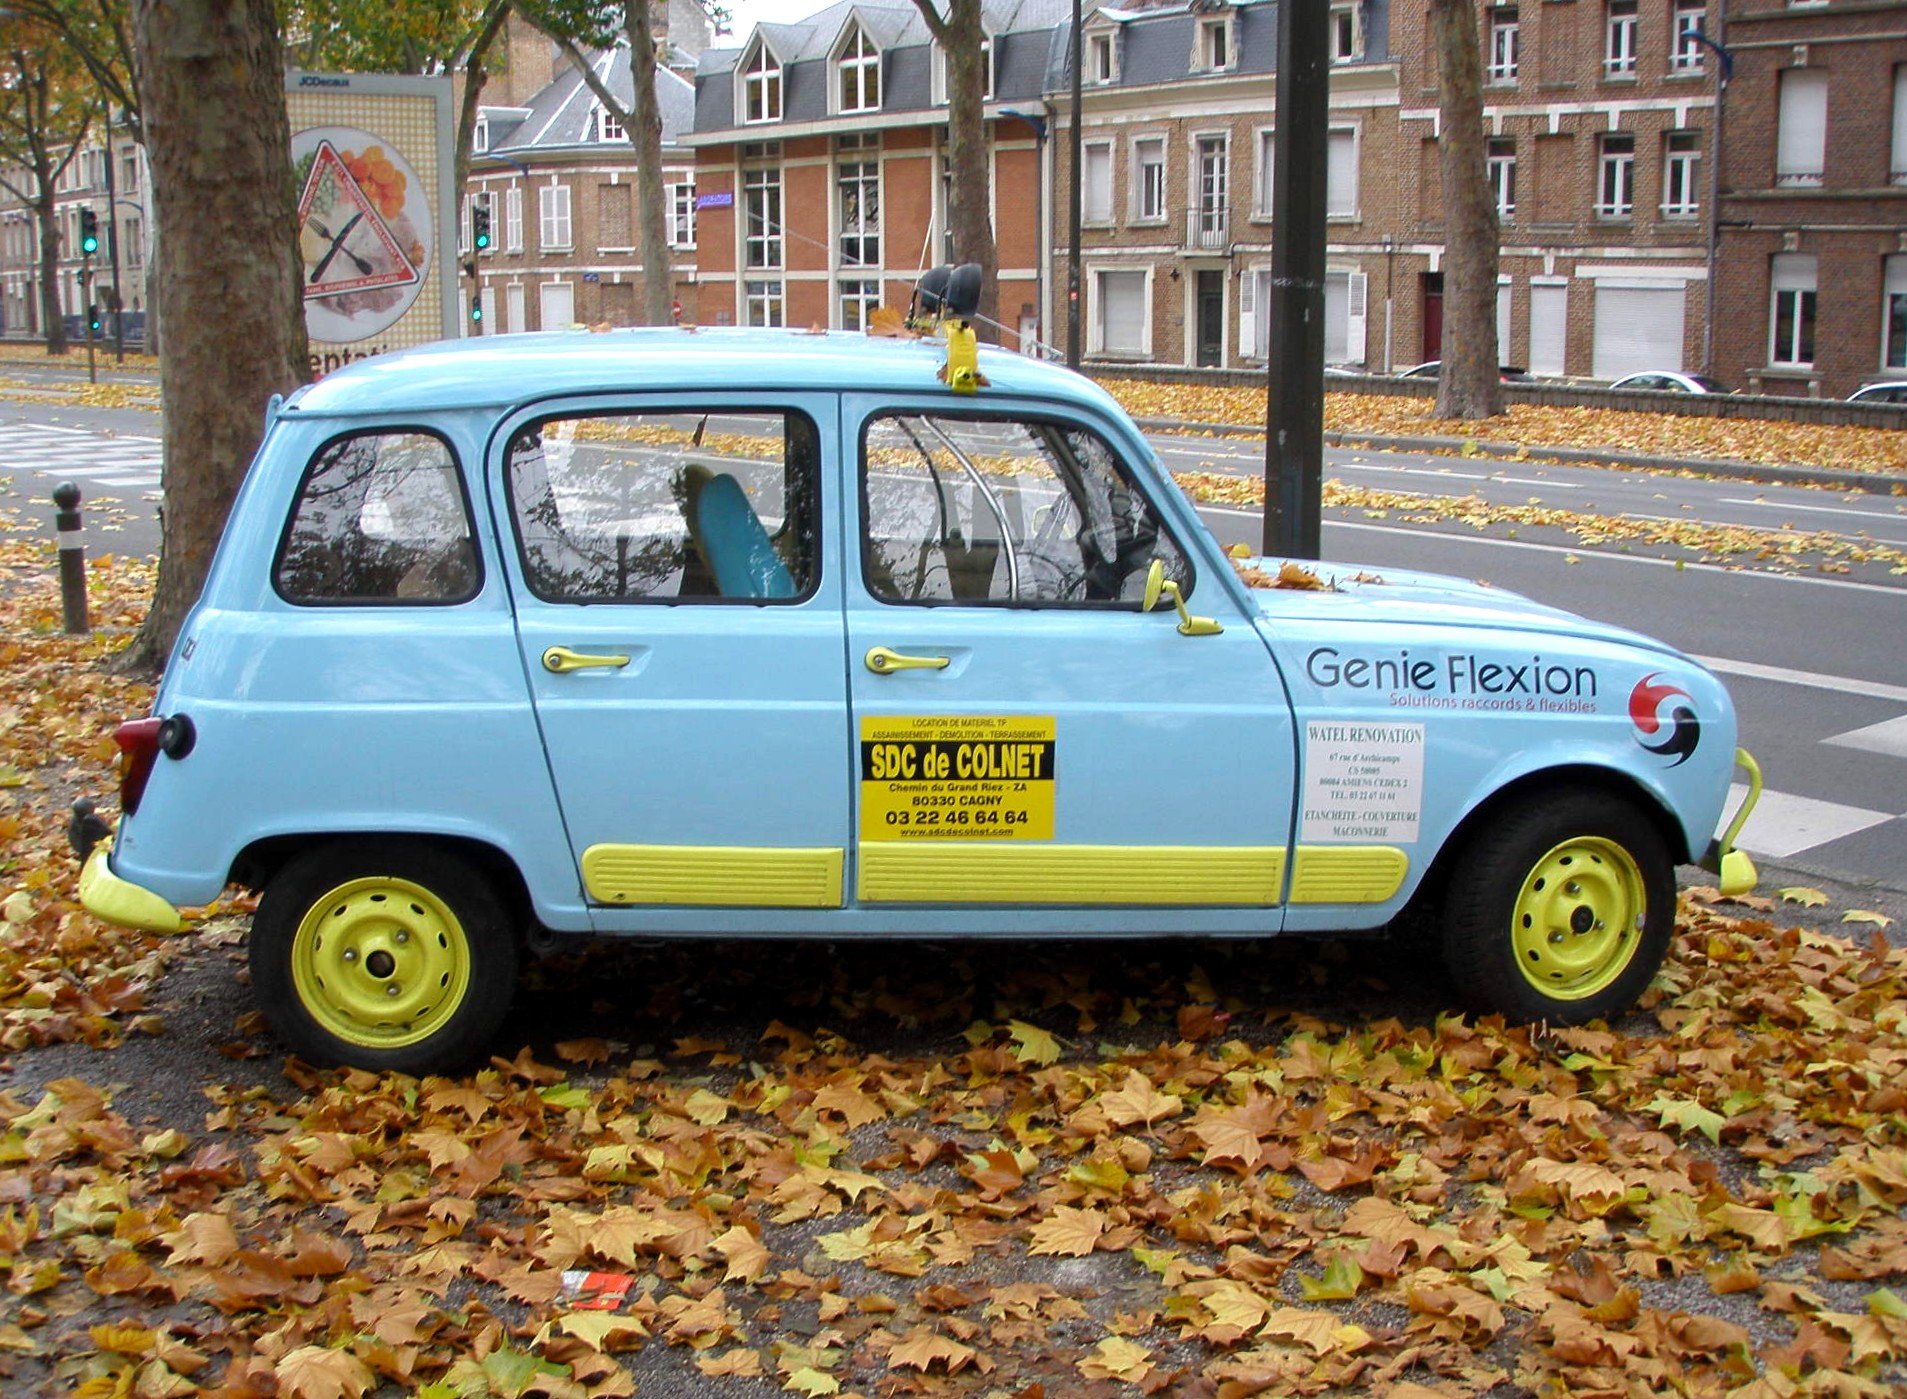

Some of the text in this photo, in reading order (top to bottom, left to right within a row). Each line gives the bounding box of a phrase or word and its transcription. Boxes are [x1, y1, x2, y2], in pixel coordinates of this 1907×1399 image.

[1306, 647, 1596, 697] Genie Flexion
[1390, 692, 1597, 713] Solutions raccords & flexibles
[912, 719, 948, 728] LOCATION
[950, 719, 960, 728] DE
[961, 719, 995, 728] MATERIEL
[872, 730, 933, 739] ASSAINISSEMENT
[940, 730, 984, 739] DEMOLITION
[990, 730, 1046, 739] TERRASSEMENT
[1309, 726, 1421, 743] WATEL RENOVATION
[871, 743, 1045, 779] SDC de COLNET
[889, 782, 927, 792] Chemin
[932, 783, 944, 792] du
[947, 783, 977, 792] Grand
[981, 783, 1003, 792] Riez
[1013, 783, 1027, 792] ZA
[912, 795, 1002, 806] 80330 CAGNY
[885, 811, 1028, 825] 03 22 46 64 64
[900, 829, 1014, 837] www.sdcdecolnet.com
